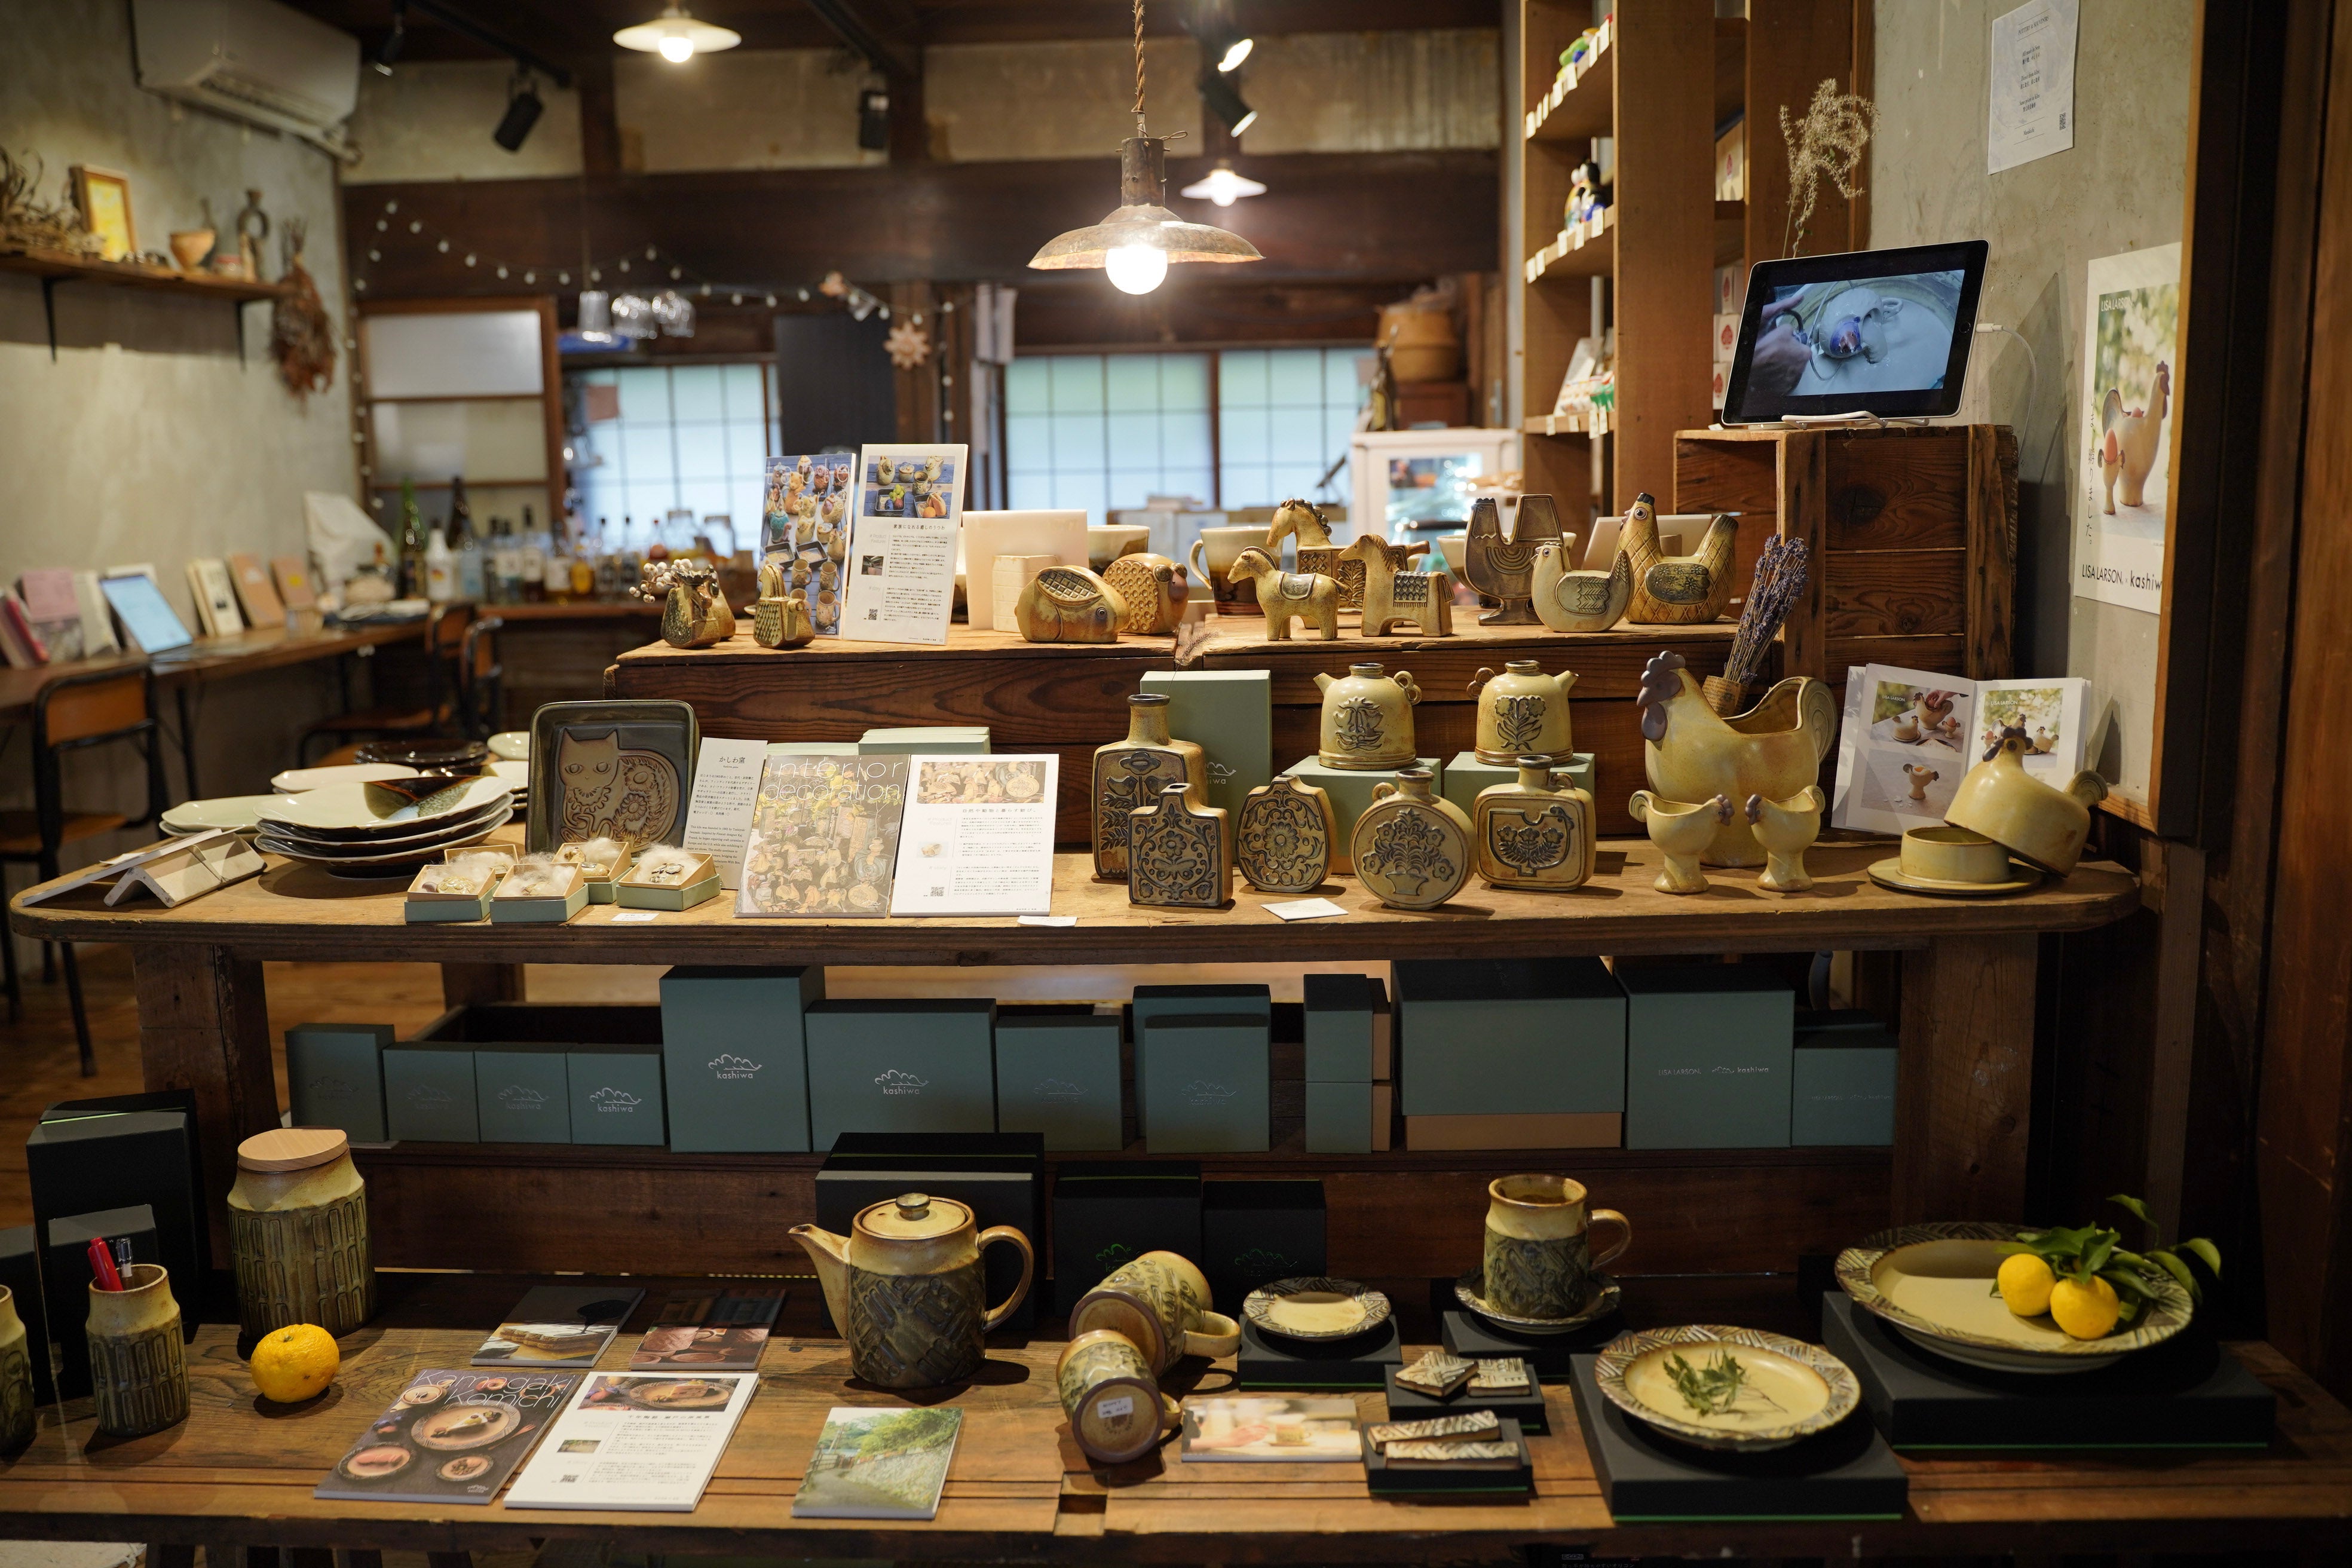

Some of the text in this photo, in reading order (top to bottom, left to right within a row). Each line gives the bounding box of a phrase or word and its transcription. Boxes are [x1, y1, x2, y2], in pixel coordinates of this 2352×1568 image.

[2101, 299, 2112, 311] LISA
[2082, 564, 2096, 579] LISA
[2130, 569, 2163, 591] kashiw
[767, 757, 904, 778] interior
[763, 778, 901, 801] decoration
[716, 1070, 754, 1080] kashiwa
[883, 1085, 921, 1095] kashiwa
[597, 1103, 633, 1113] kashiwa
[413, 1370, 575, 1394] Kamagaki
[444, 1388, 563, 1408] Komichi
